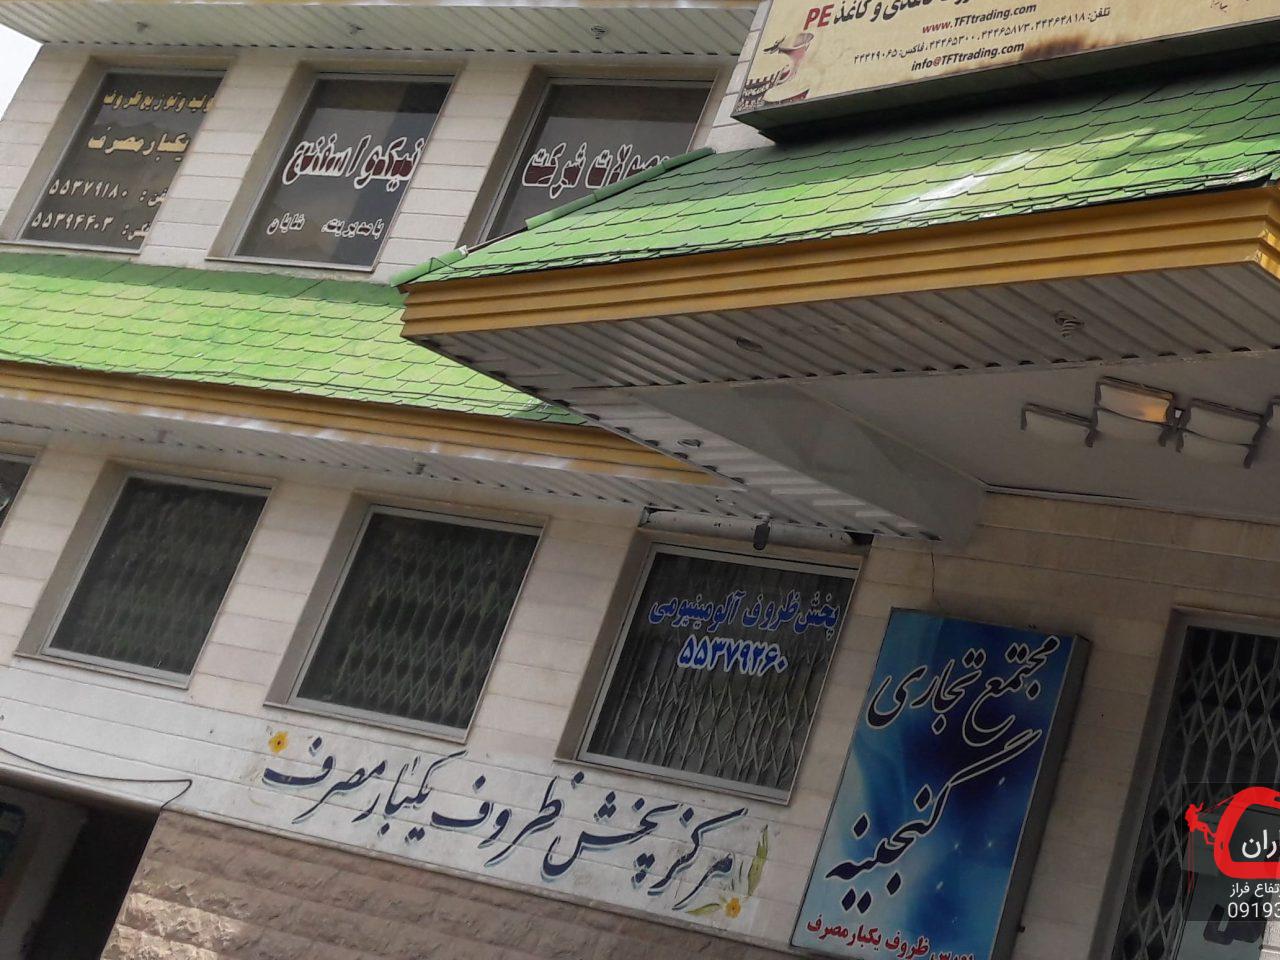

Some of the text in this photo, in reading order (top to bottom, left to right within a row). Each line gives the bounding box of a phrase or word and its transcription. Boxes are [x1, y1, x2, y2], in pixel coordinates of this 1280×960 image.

[803, 4, 835, 31] PE
[911, 41, 1025, 72] info@TFTtrading.com
[922, 3, 1037, 34] www.TFTtrading.com
[866, 635, 1060, 747] مجتمع تجاری
[431, 771, 585, 867] ظروف
[648, 807, 748, 911] مرکز
[824, 729, 1043, 915] گنجینه
